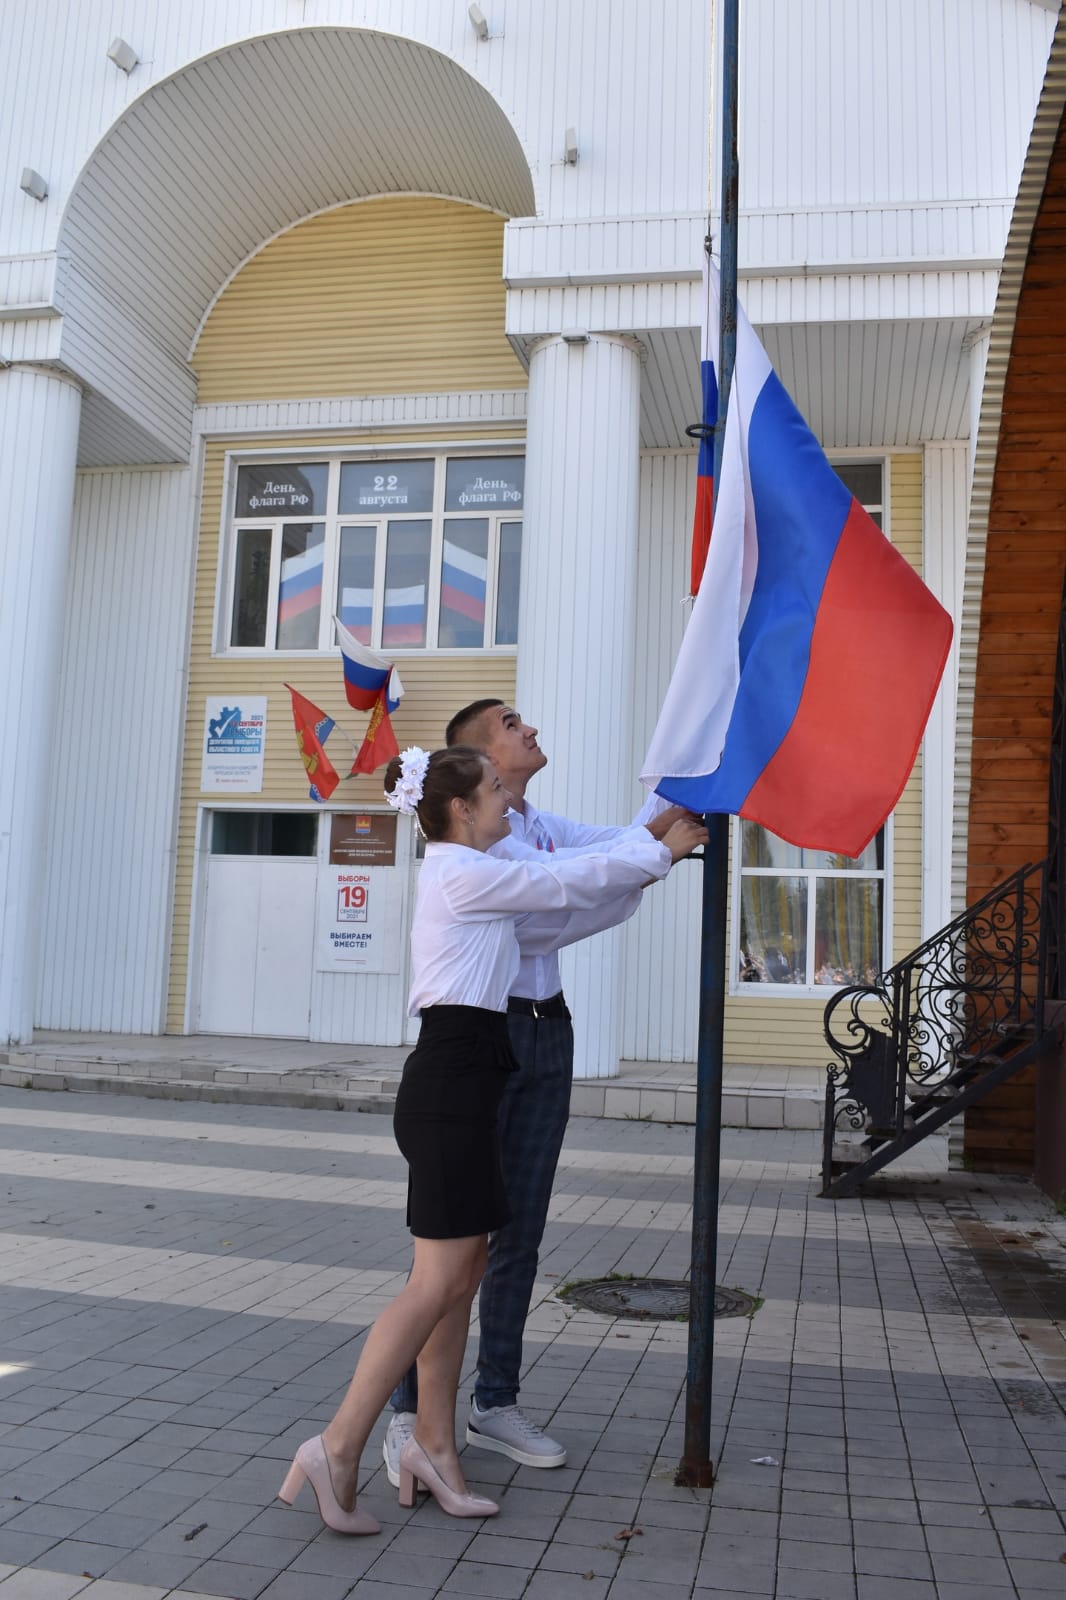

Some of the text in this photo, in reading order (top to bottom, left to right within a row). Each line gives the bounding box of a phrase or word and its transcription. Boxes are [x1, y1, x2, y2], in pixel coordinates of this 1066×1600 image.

[264, 482, 295, 494] День
[373, 476, 398, 491] 22
[474, 478, 508, 490] День
[249, 494, 309, 507] флага РФ
[359, 494, 408, 507] августа
[458, 491, 521, 506] флага РФ
[340, 886, 366, 908] 19
